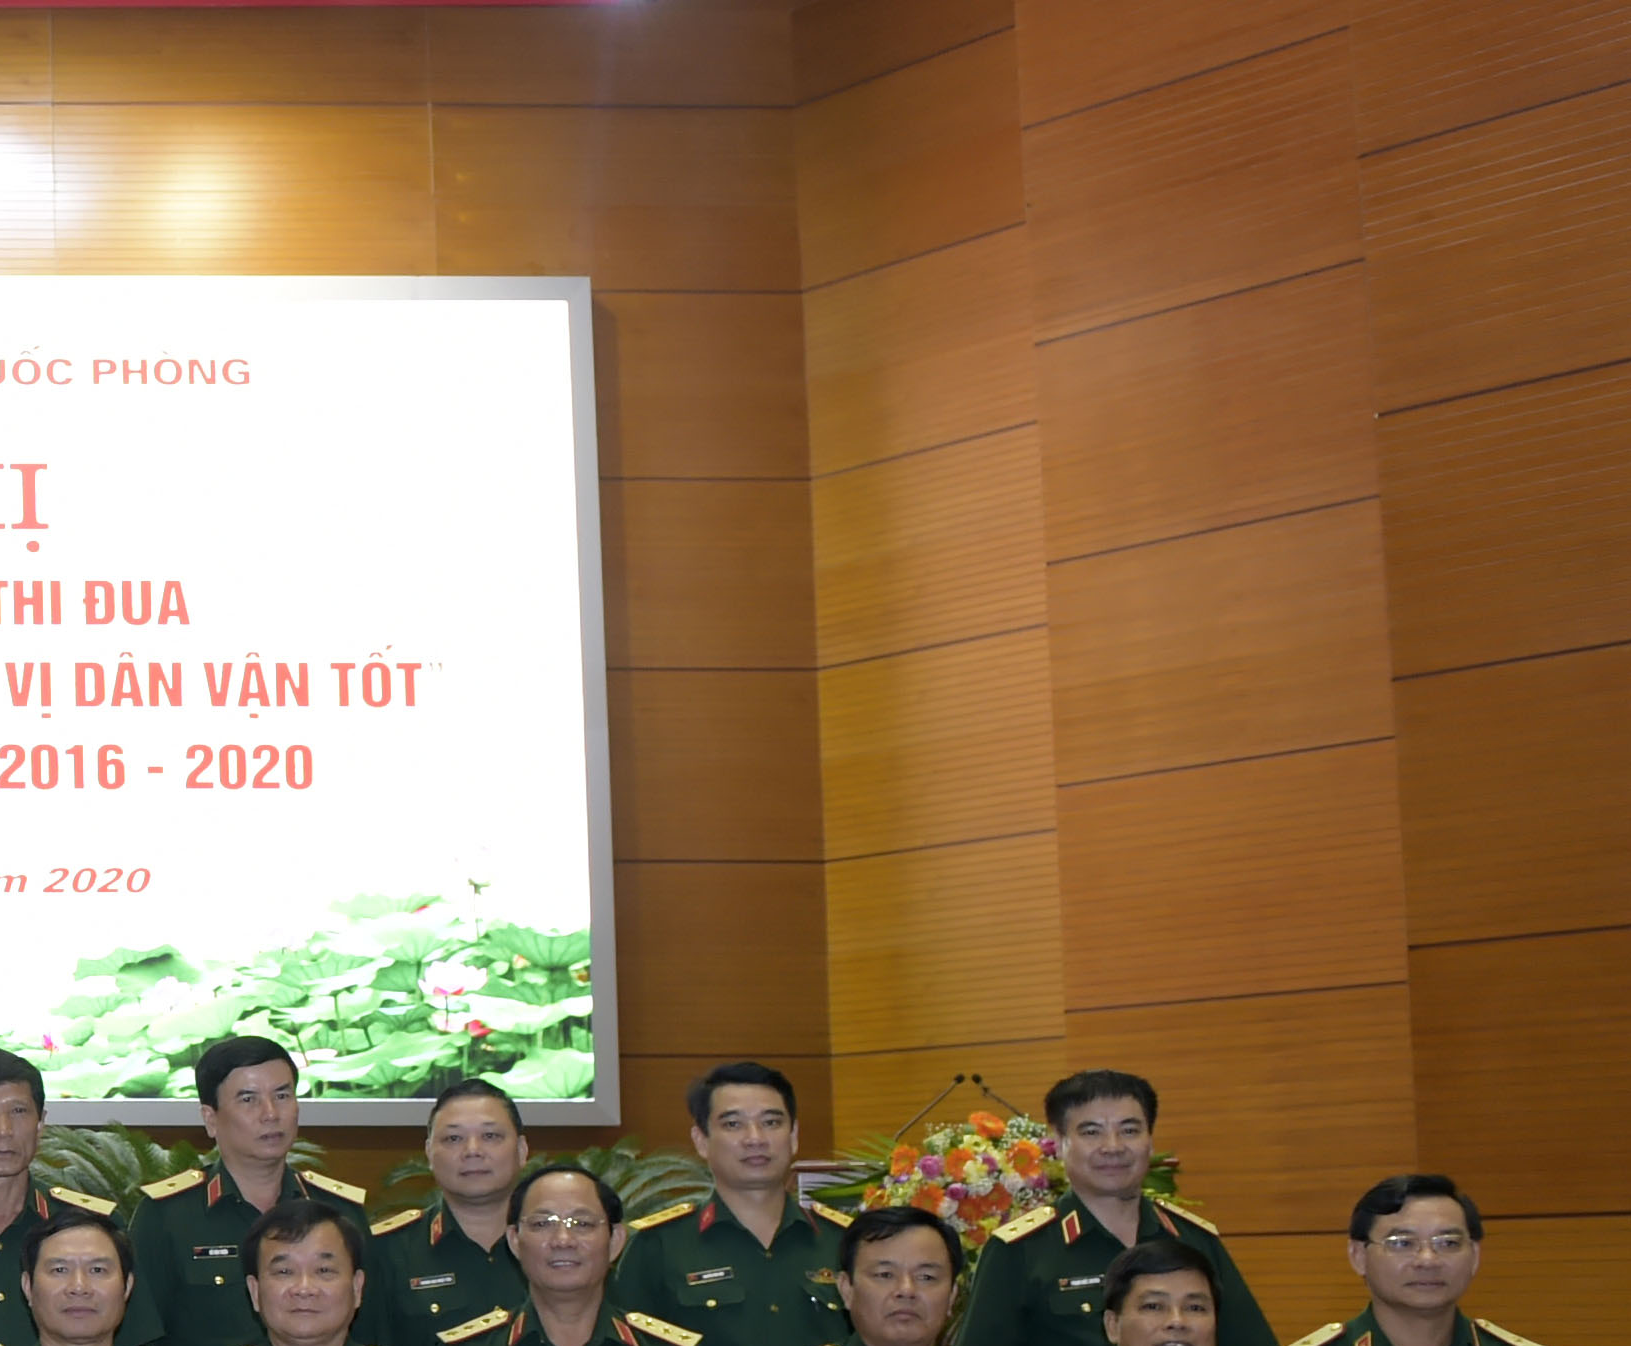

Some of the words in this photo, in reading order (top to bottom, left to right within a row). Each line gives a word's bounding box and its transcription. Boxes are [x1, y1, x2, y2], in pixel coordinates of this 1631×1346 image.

[92, 350, 251, 386] PHÒNG
[83, 580, 190, 626] ĐUA
[5, 662, 51, 718] VỊ
[75, 652, 183, 707] DÂN
[203, 652, 309, 719] VẬN
[147, 766, 163, 774] -
[187, 744, 313, 790] 2020
[43, 868, 151, 893] 2020
